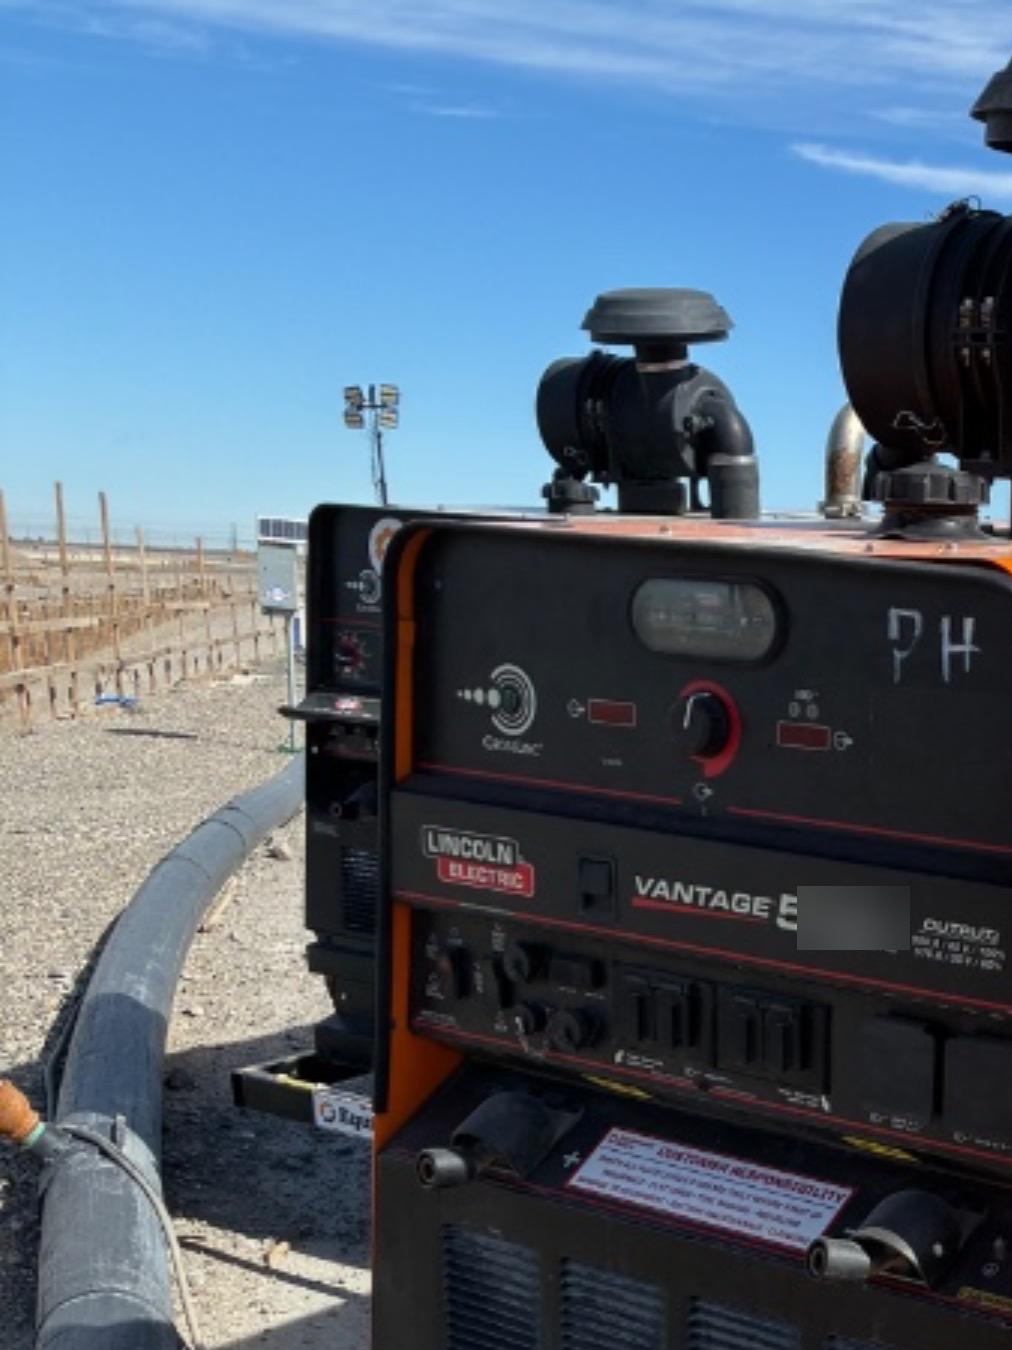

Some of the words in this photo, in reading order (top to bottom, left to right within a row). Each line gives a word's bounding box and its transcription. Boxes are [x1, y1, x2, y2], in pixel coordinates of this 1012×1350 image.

[427, 831, 513, 866] LINCOLN
[446, 862, 524, 889] ELECTRIC
[635, 876, 770, 919] VANTAGE
